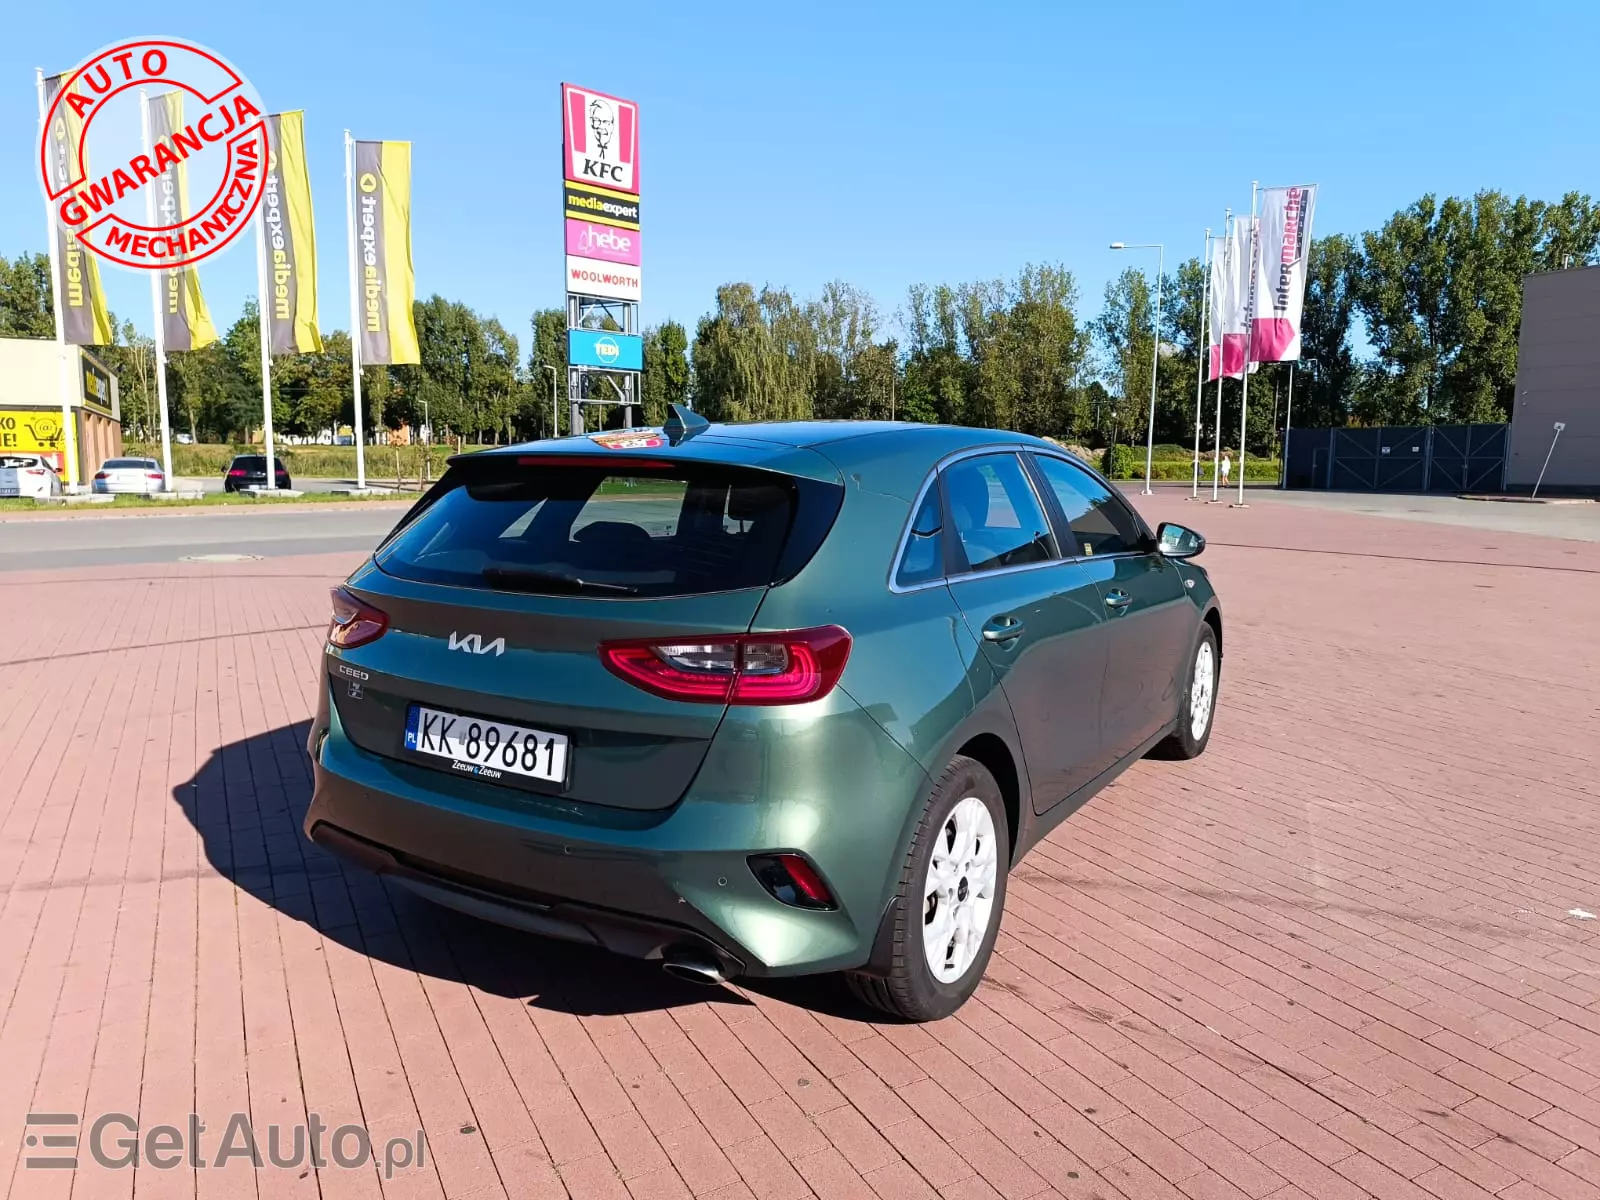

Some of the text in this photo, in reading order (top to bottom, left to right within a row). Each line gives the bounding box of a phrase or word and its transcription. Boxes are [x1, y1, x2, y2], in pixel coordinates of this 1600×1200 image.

[583, 158, 623, 182] KFC
[568, 195, 637, 217] mediaexpert
[588, 225, 632, 251] hebe
[571, 269, 638, 288] WOOLWORTH
[448, 631, 505, 656] KIA
[339, 665, 369, 680] CEED
[407, 732, 416, 743] PL
[421, 713, 555, 776] KK 89681
